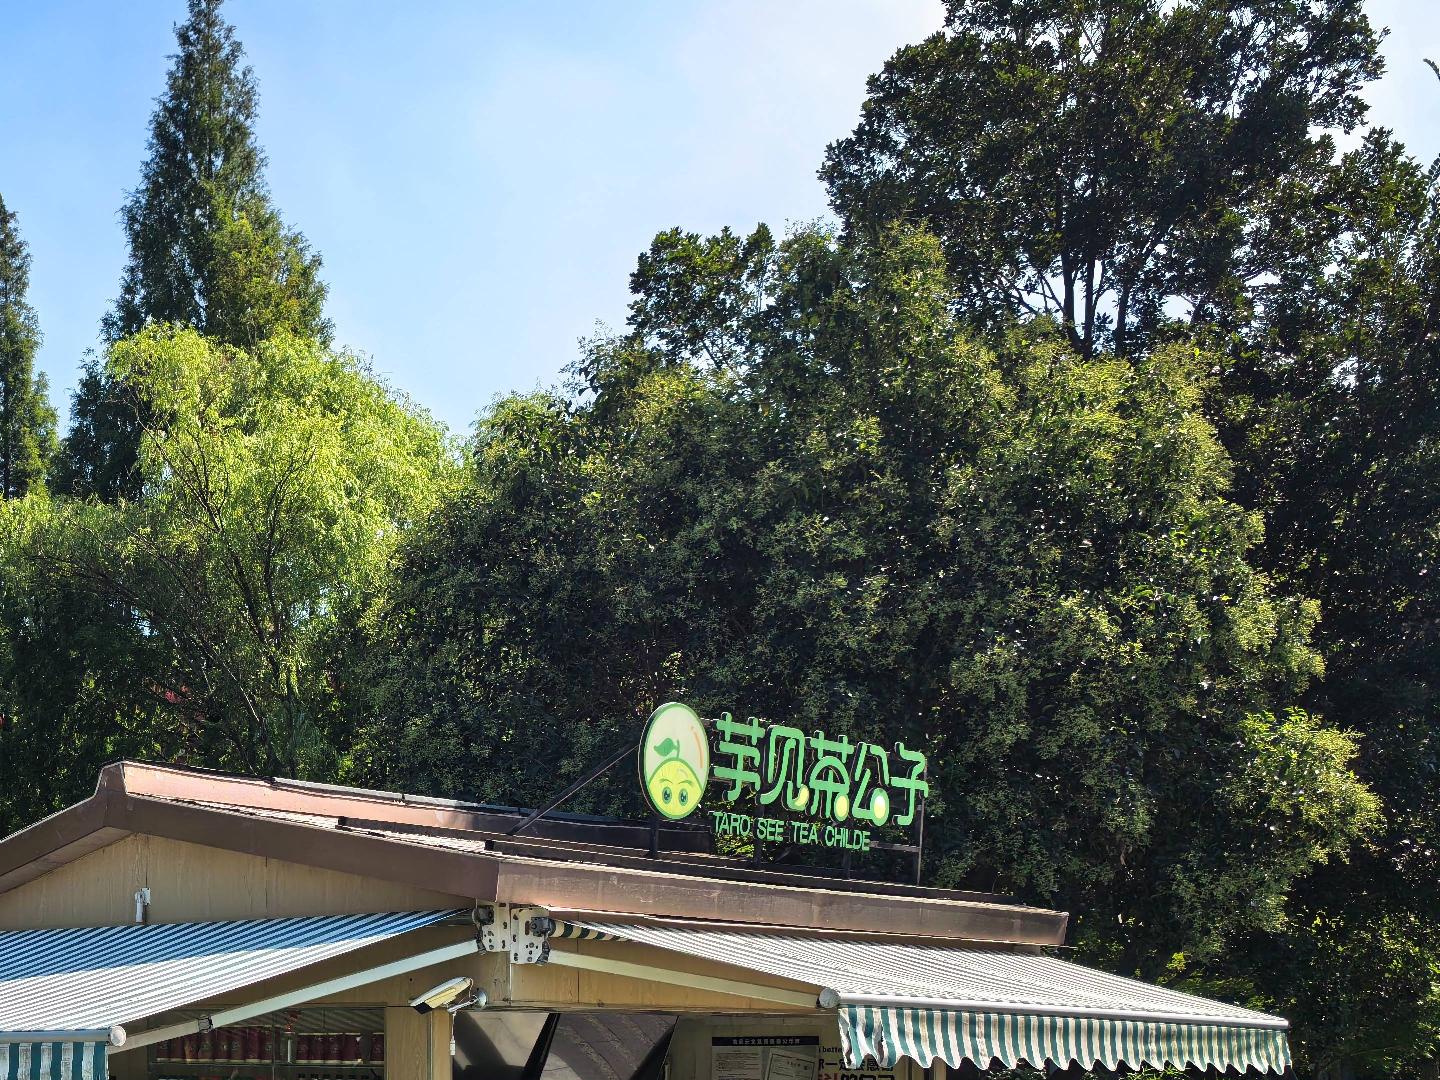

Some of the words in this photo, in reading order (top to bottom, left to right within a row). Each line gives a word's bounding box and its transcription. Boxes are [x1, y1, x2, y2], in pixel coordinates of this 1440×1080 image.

[713, 811, 751, 837] TARO
[757, 817, 784, 842] SEE
[792, 823, 818, 845] TEA
[825, 827, 870, 851] CHILDE
